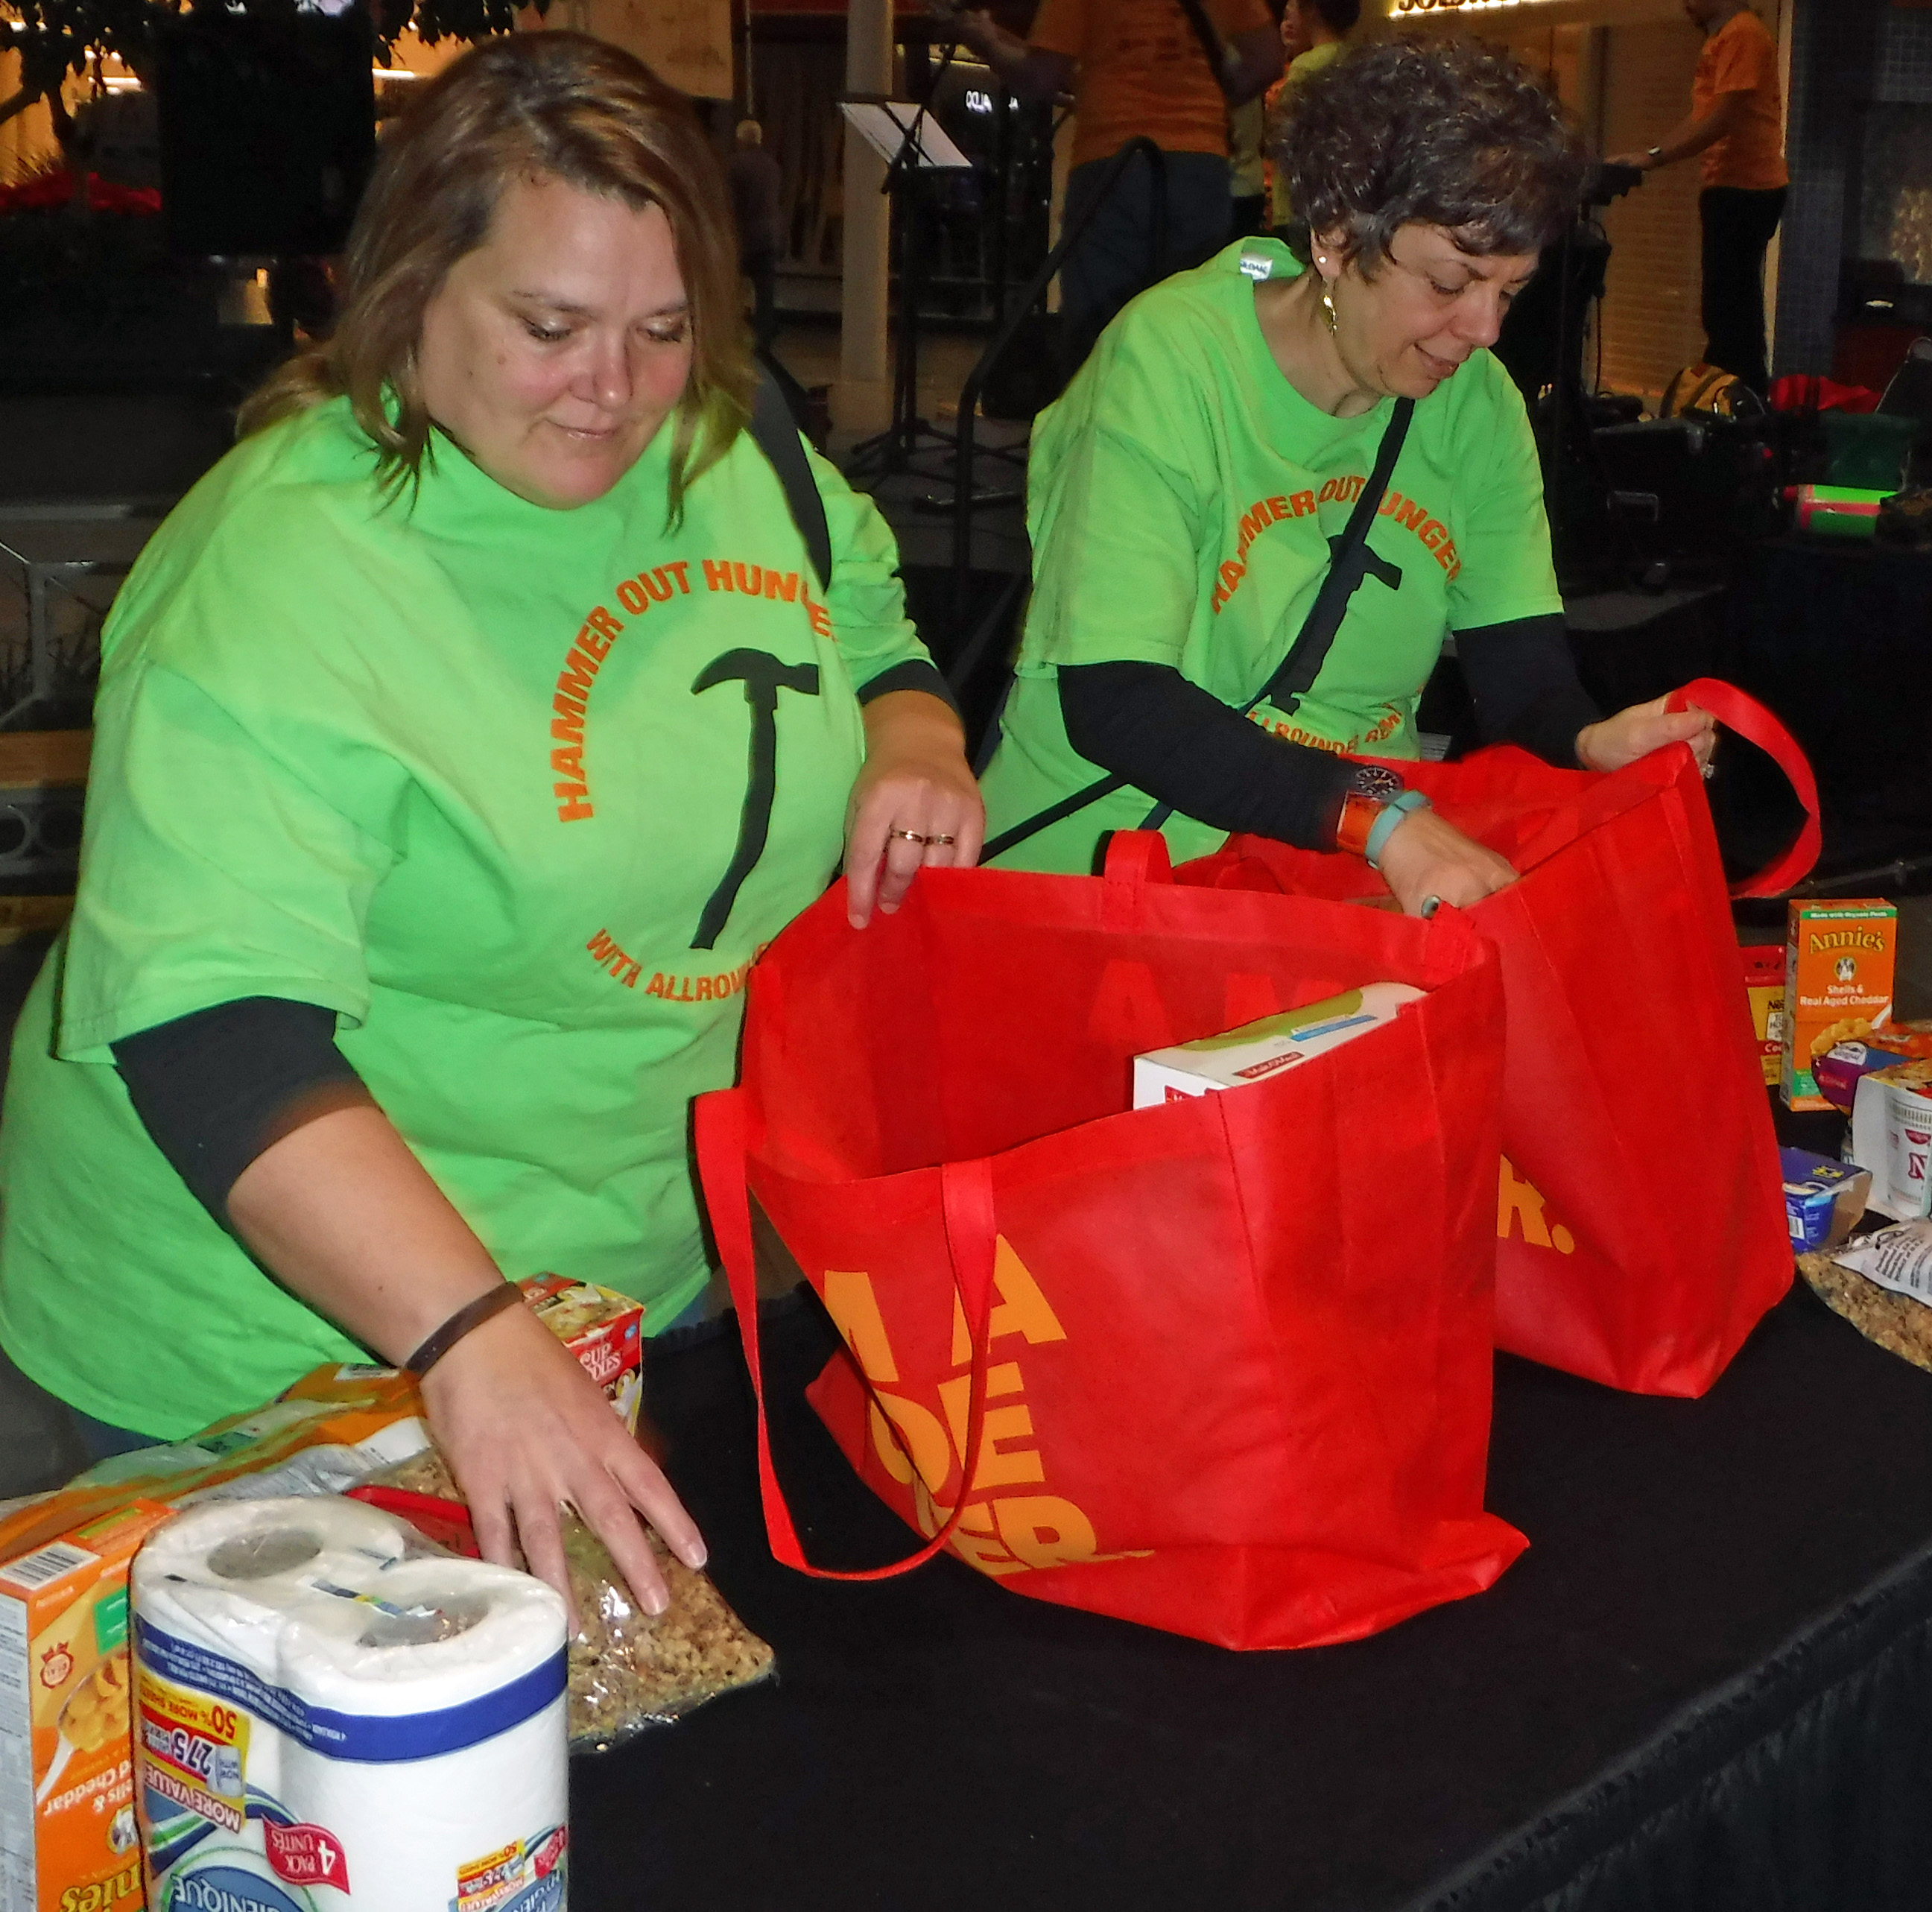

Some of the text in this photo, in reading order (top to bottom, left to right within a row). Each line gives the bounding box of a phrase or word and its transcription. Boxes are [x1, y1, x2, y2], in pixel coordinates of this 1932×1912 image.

[1318, 475, 1366, 503] OUT
[550, 605, 624, 823] HAMMER
[616, 560, 690, 615] OUT
[1810, 926, 1885, 954] Annie's
[1800, 995, 1889, 1007] Real Aged Cheddar
[580, 1343, 613, 1367] CUP
[44, 1767, 116, 1816] Cheddar
[285, 1853, 315, 1873] PACK
[317, 1840, 336, 1875] 4
